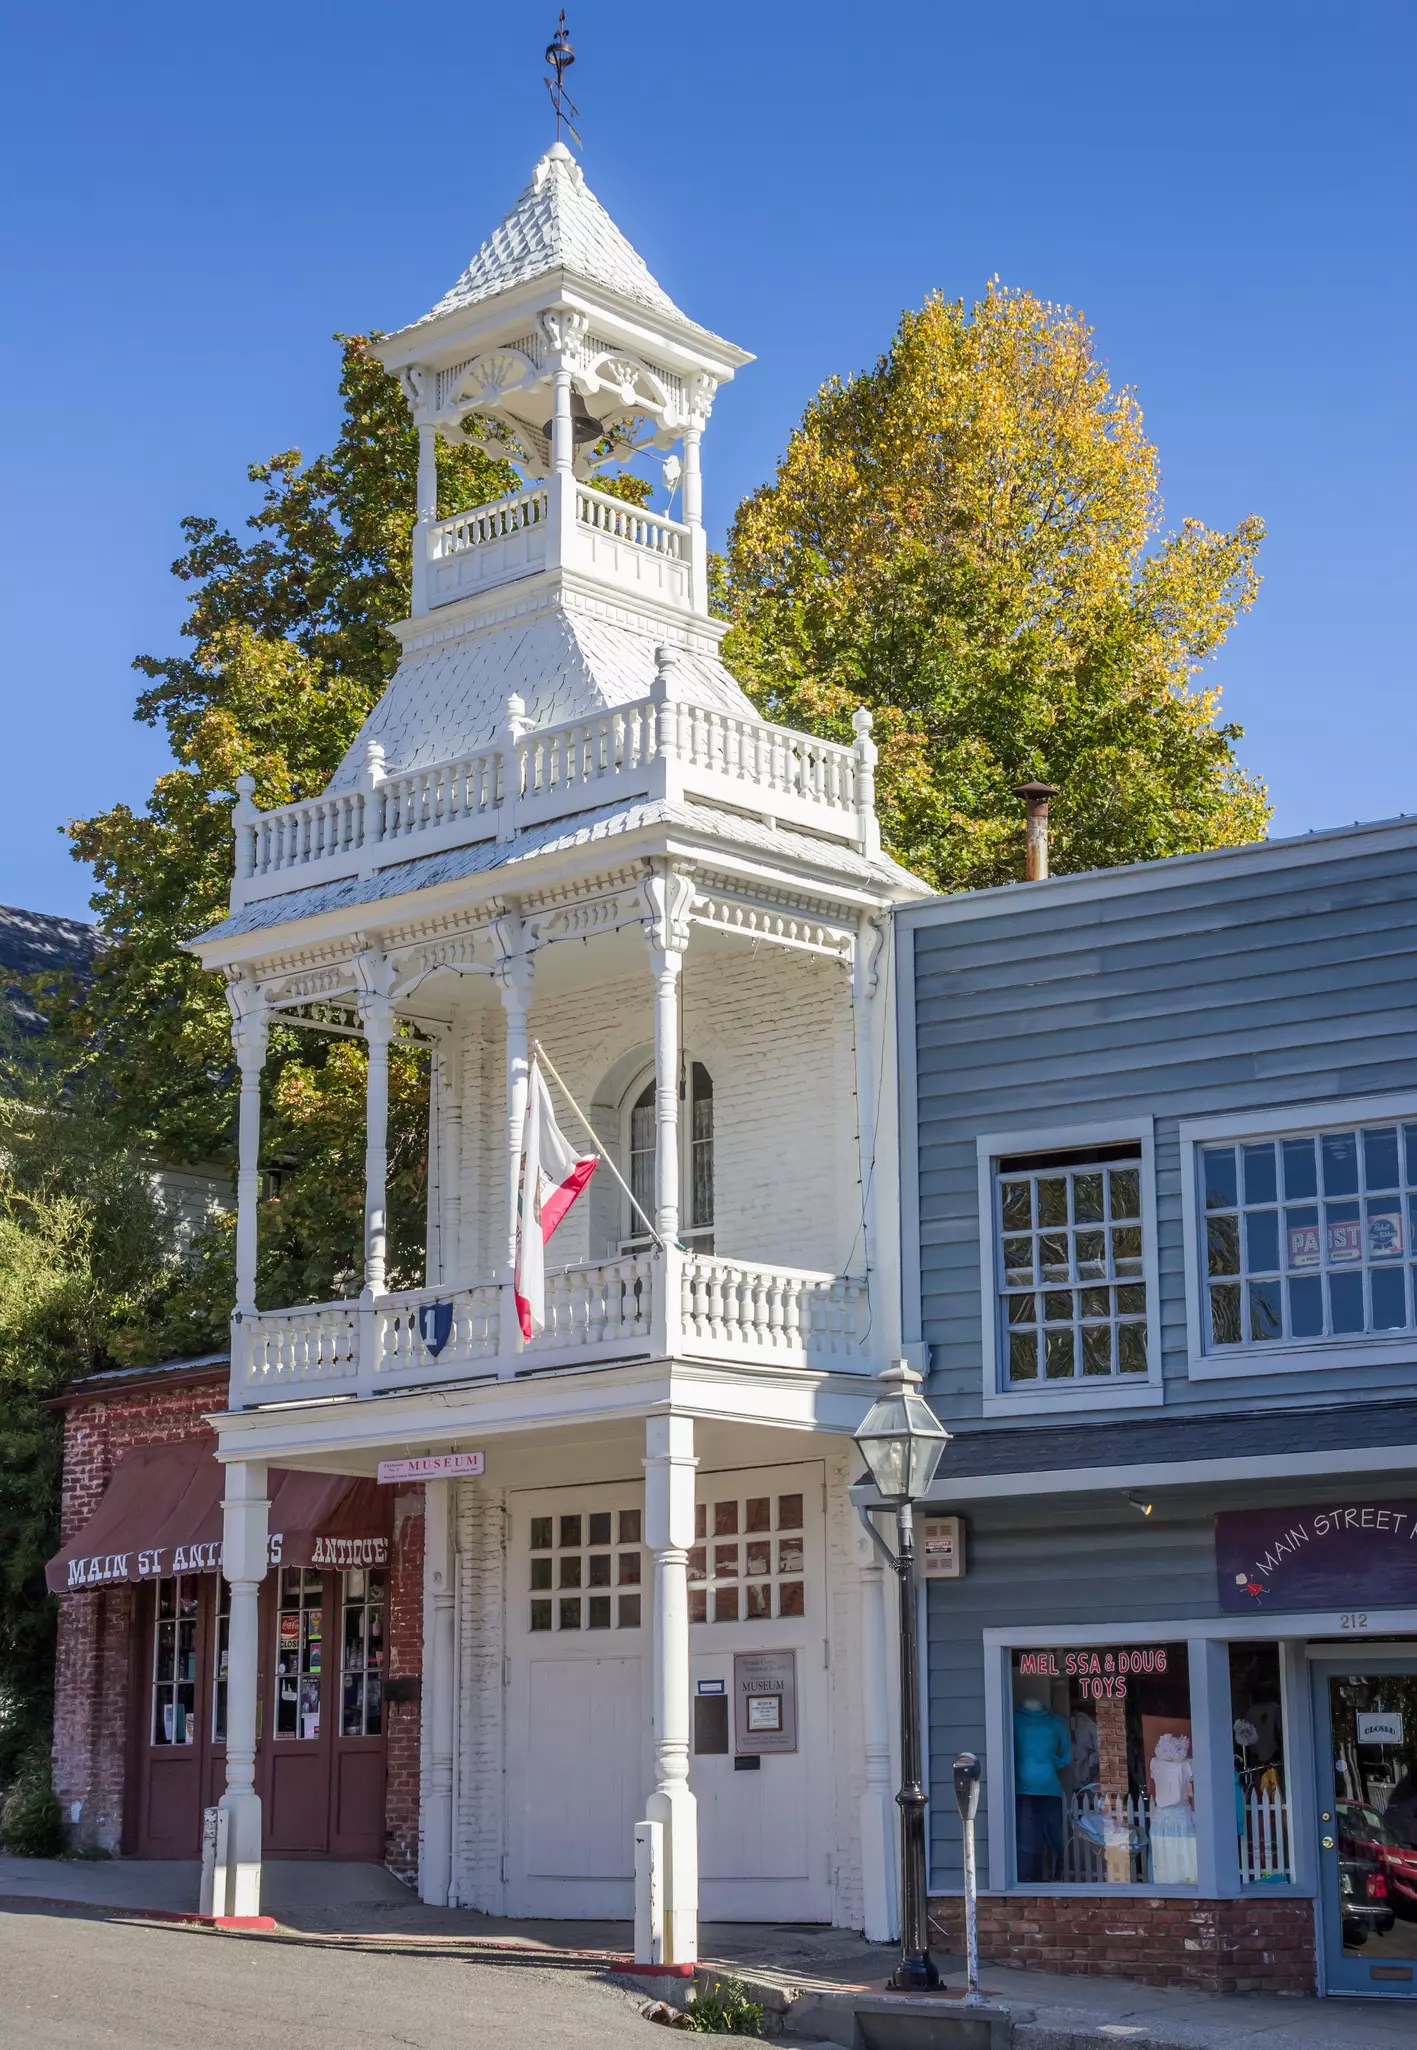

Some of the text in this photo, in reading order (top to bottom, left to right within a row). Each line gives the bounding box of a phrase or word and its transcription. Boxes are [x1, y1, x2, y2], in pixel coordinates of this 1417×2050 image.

[423, 1309, 437, 1345] 1
[408, 1455, 478, 1471] MUSEUM
[1255, 1523, 1310, 1577] MAIN
[1313, 1508, 1408, 1536] STREET
[67, 1533, 283, 1586] MAIN ST ANTIS
[1340, 1613, 1368, 1629] 212
[280, 1640, 300, 1648] CLOS
[1104, 1653, 1116, 1673] &
[1118, 1650, 1167, 1673] DOUG
[742, 1680, 785, 1692] MUSEUM
[1079, 1676, 1127, 1699] TOYS
